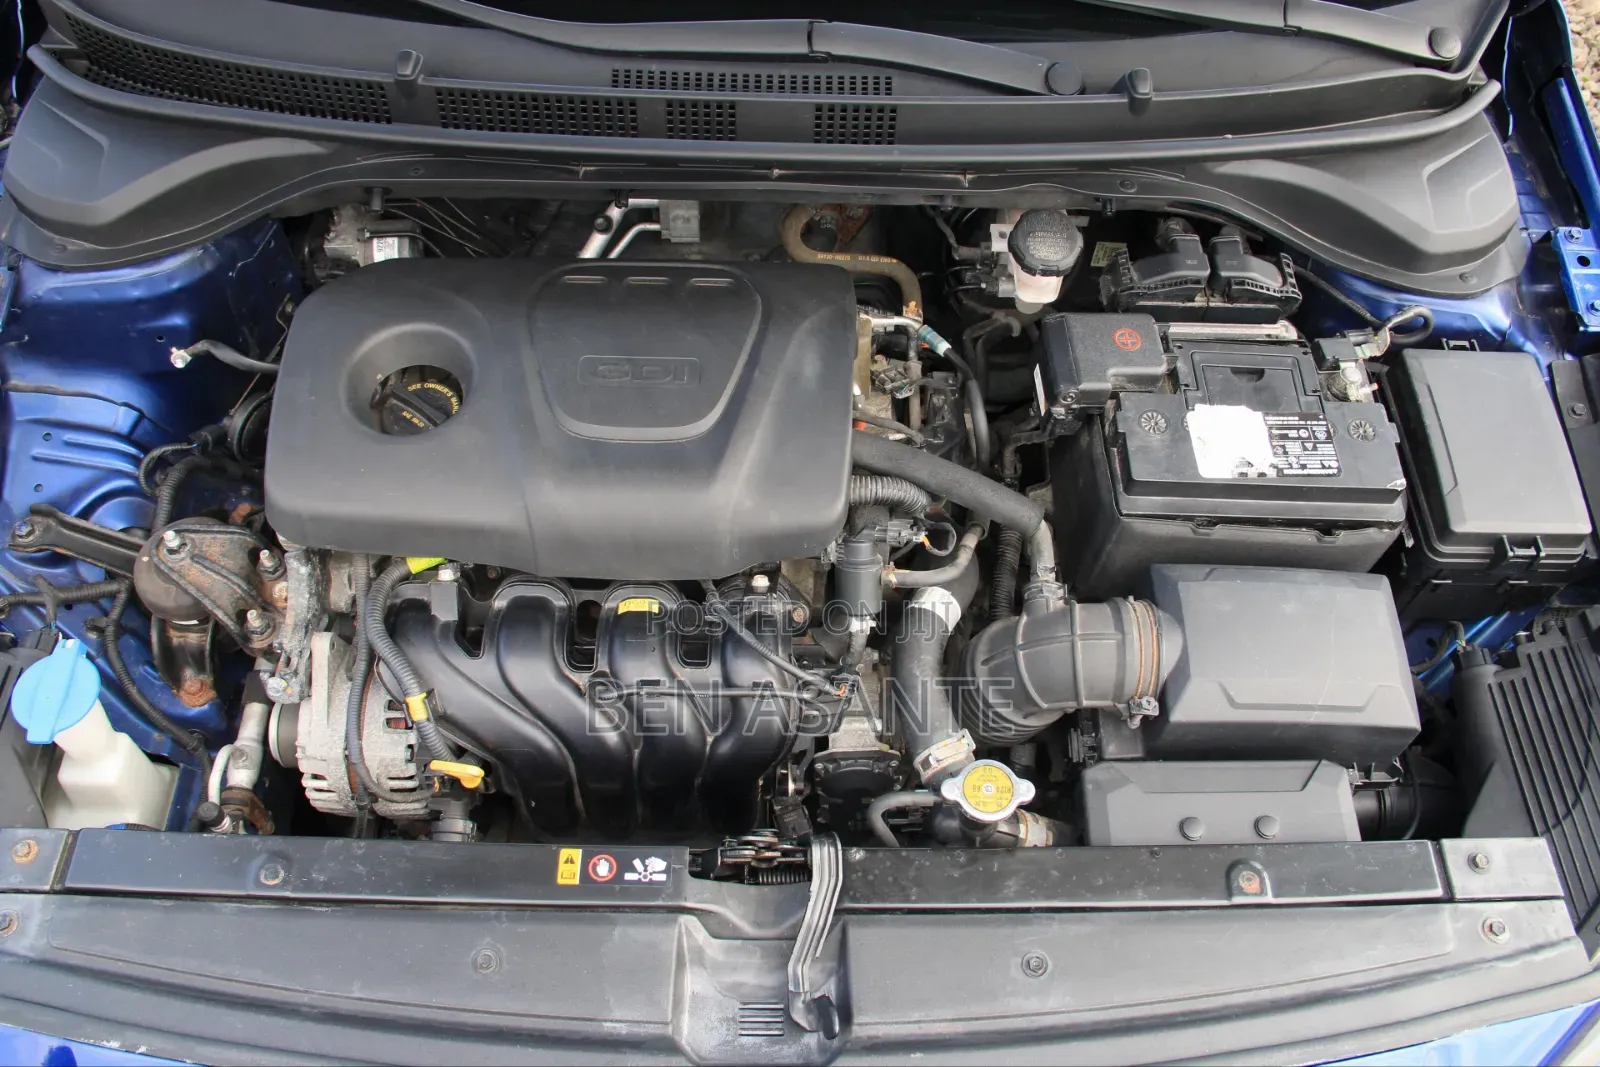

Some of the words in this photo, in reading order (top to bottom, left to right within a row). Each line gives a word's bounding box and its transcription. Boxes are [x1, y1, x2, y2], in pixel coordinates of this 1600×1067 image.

[593, 362, 689, 384] GDI
[407, 383, 422, 392] SEE
[424, 382, 453, 397] OWNER'S
